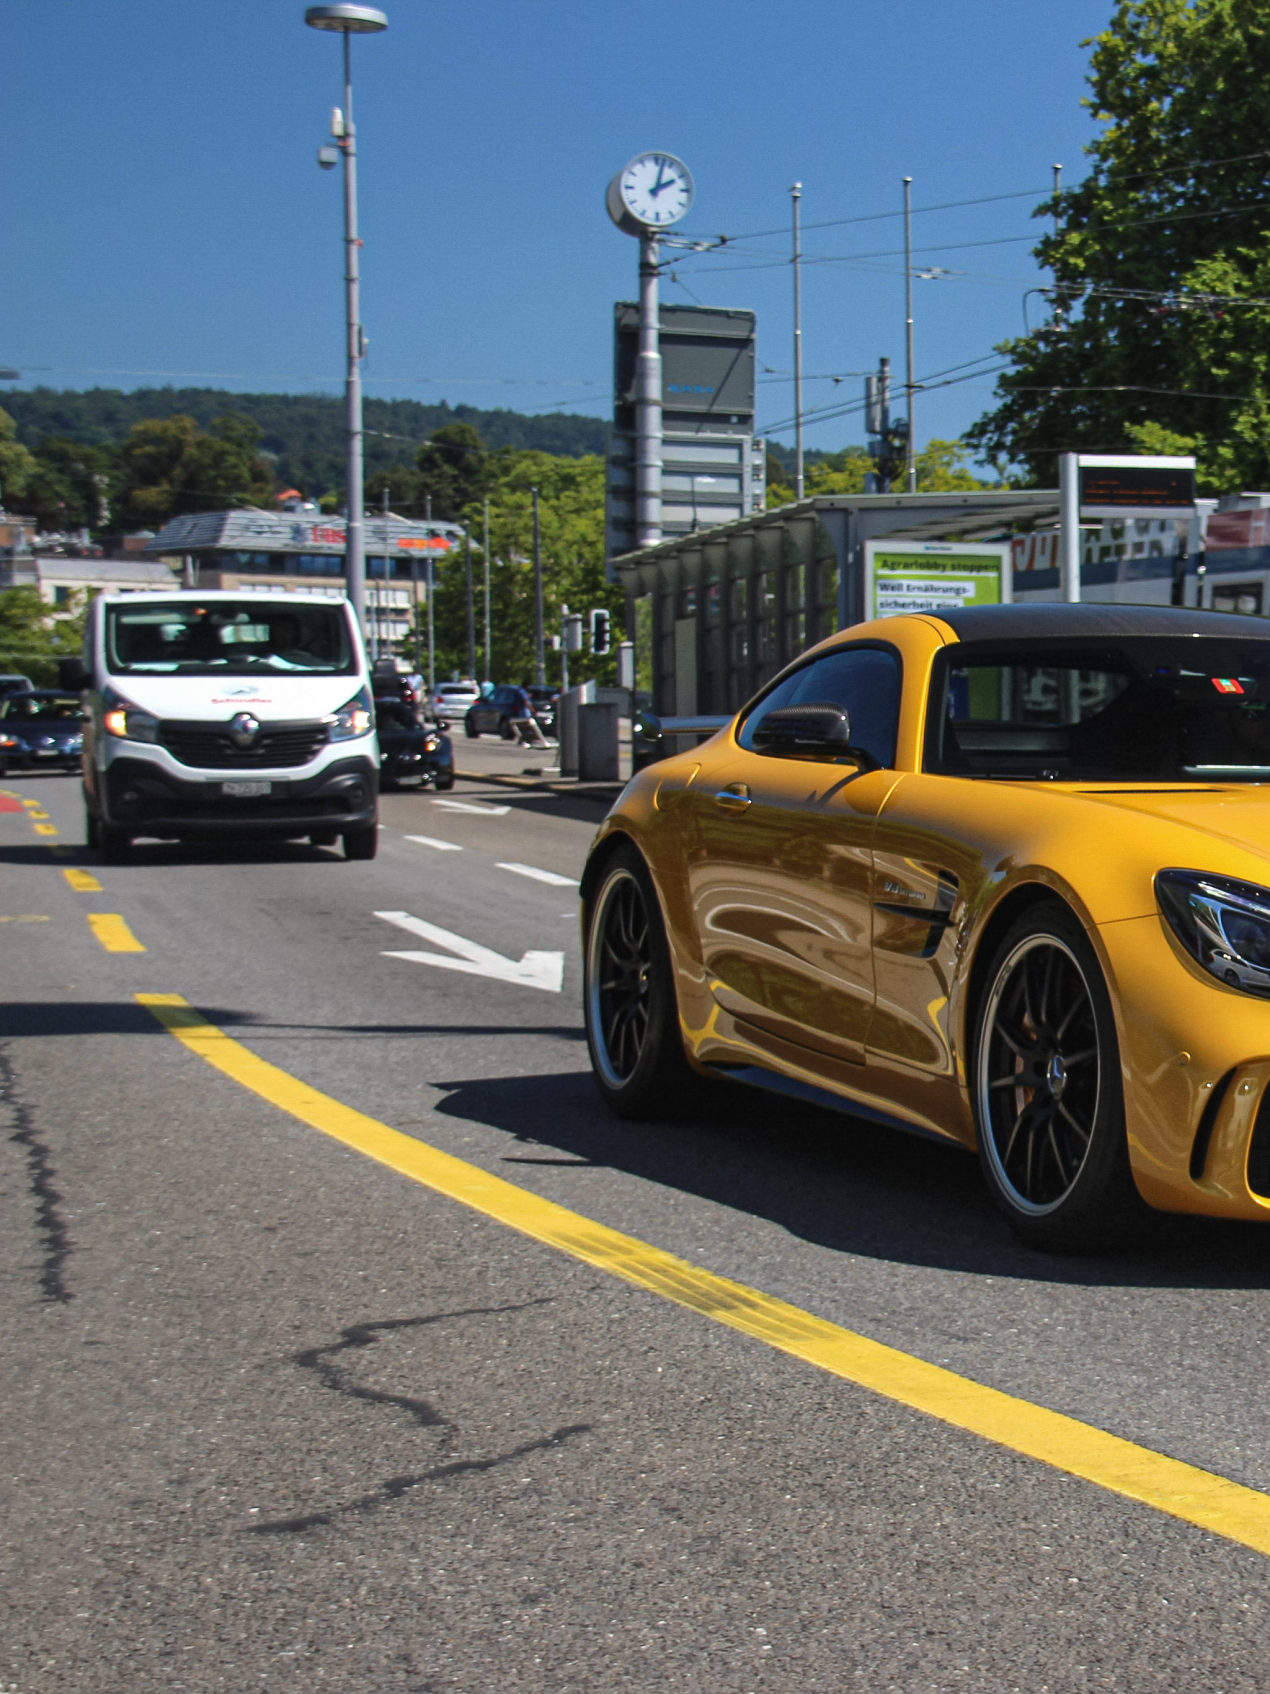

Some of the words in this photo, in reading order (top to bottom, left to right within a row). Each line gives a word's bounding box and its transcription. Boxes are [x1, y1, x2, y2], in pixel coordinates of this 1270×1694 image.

[881, 559, 947, 573] Agrarlobby
[951, 562, 1000, 574] stoppen
[878, 598, 933, 610] sicherheit
